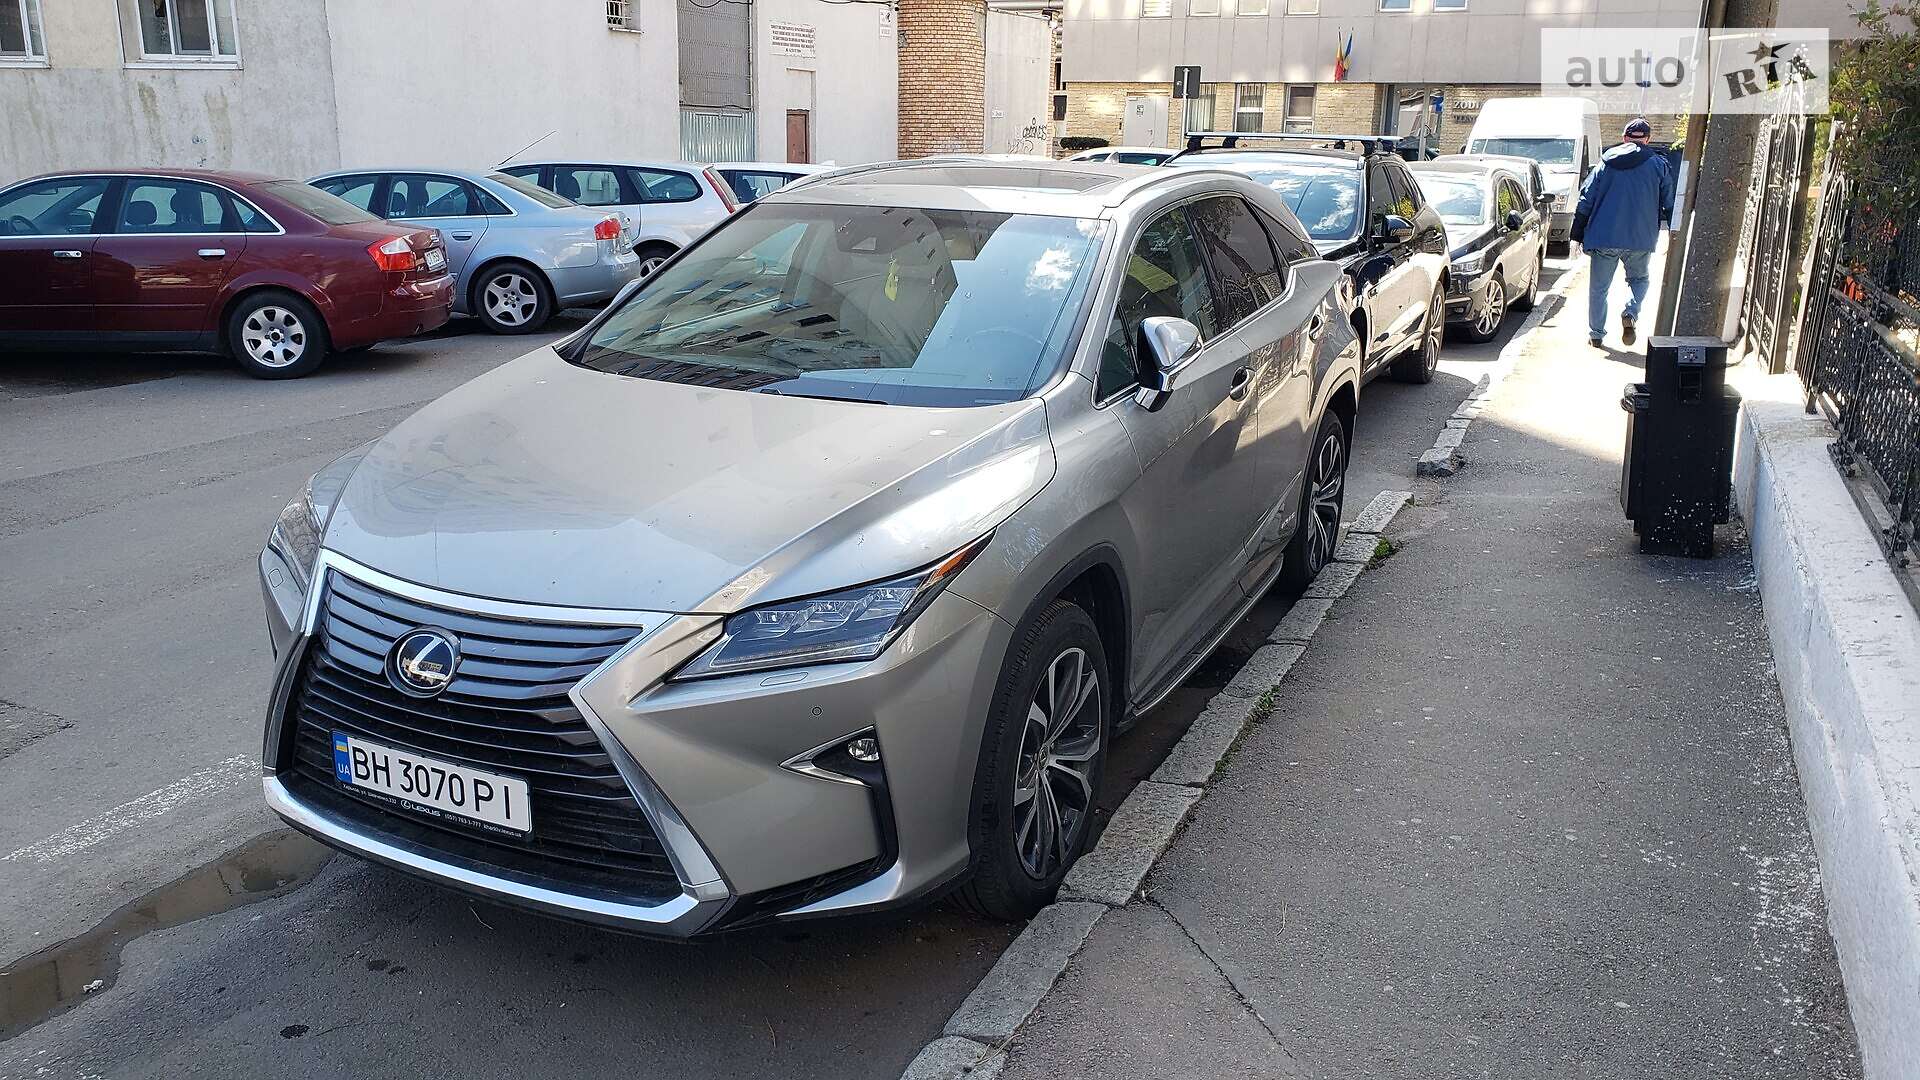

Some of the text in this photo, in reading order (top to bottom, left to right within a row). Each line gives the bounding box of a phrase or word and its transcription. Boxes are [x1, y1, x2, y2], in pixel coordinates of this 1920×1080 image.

[1453, 100, 1481, 110] ZODI
[337, 763, 350, 776] UA
[352, 745, 391, 788] BH
[398, 758, 465, 807] 3070
[411, 803, 441, 817] LEXUS
